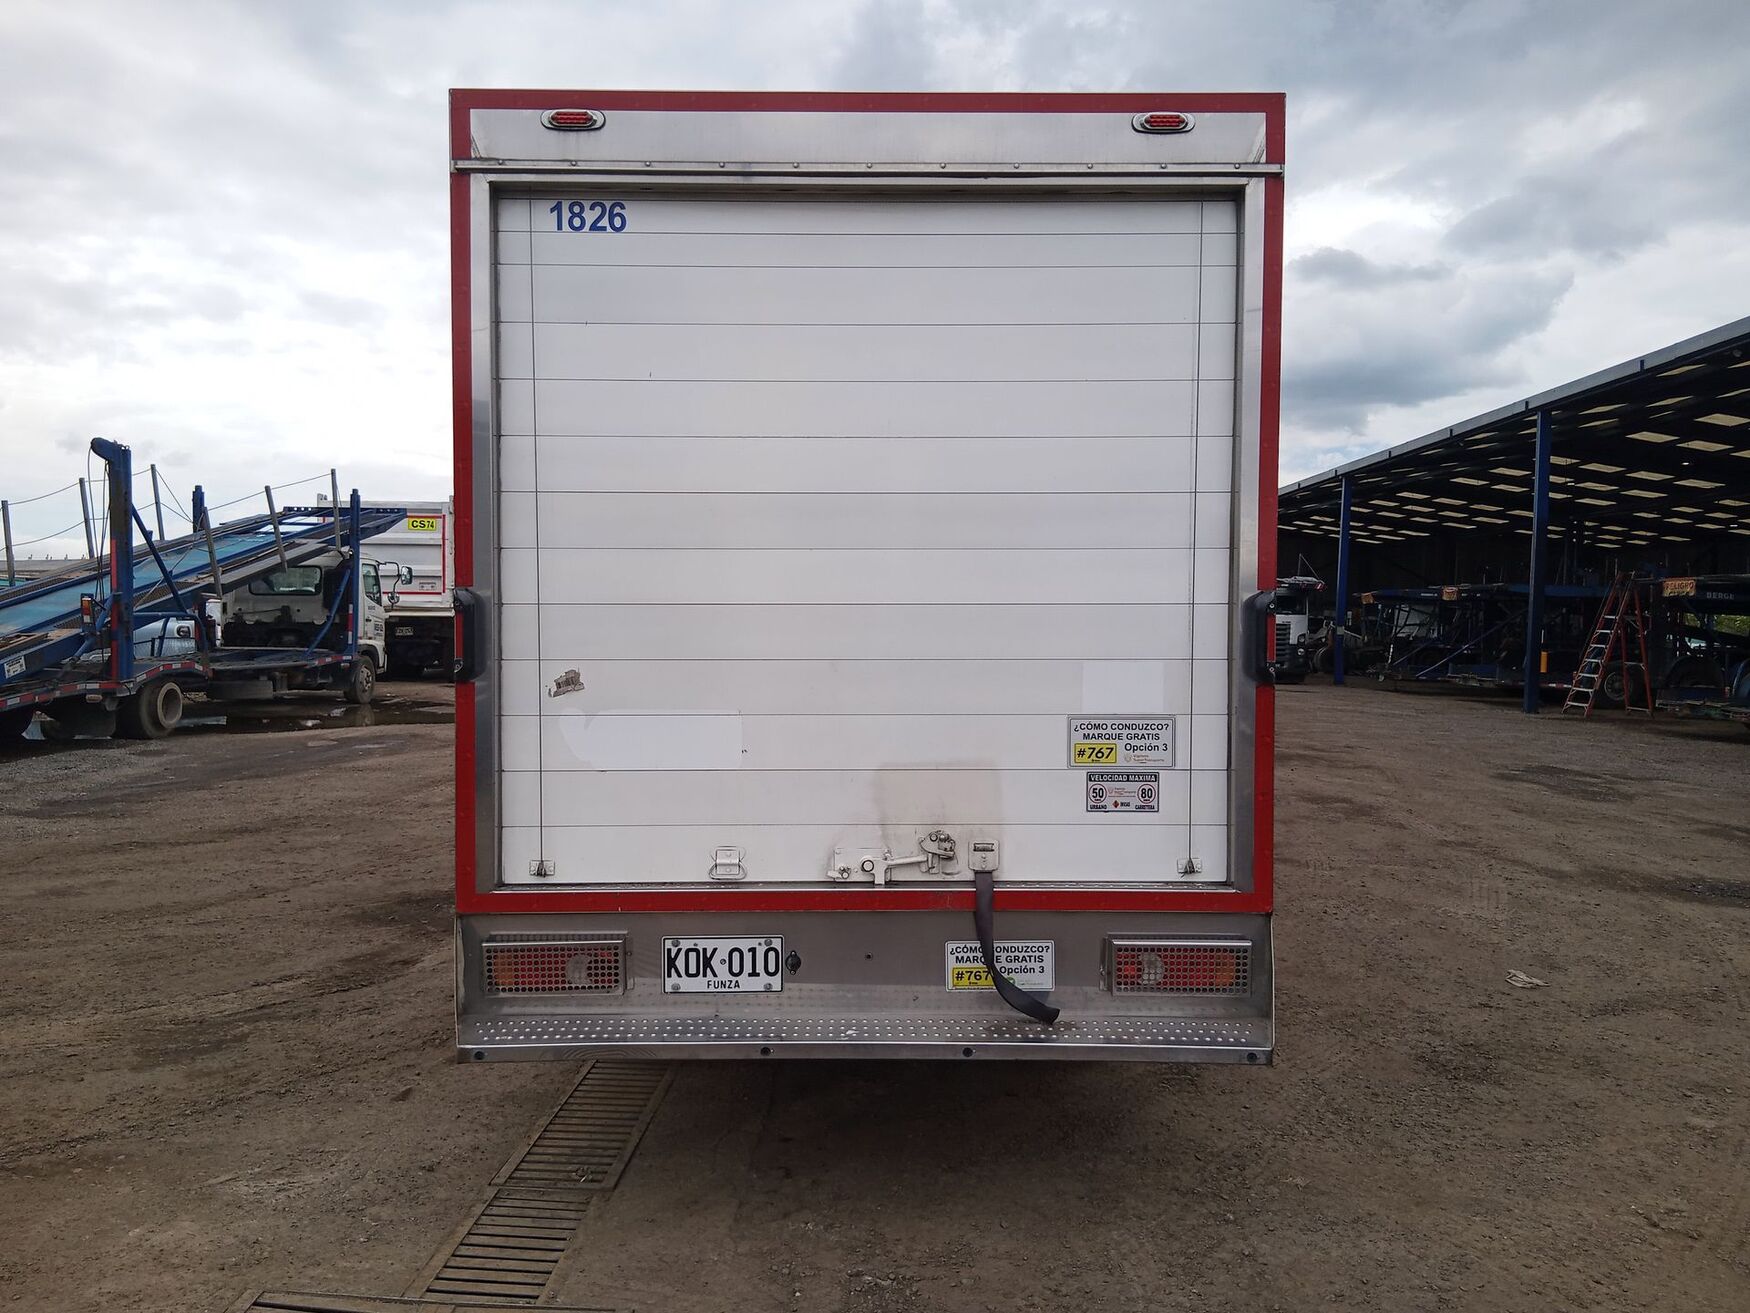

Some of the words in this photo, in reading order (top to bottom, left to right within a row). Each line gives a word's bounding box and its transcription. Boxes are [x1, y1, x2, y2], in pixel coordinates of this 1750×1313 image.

[550, 201, 627, 232] 1826
[1074, 721, 1108, 732] ¿CÓMO
[1110, 723, 1169, 731] CONDUZCO?
[1082, 733, 1123, 741] MARQUE
[1077, 747, 1114, 759] #767
[1124, 743, 1159, 753] Opción
[1162, 743, 1168, 751] 3
[1092, 787, 1104, 798] 50
[1141, 787, 1153, 798] 80
[993, 945, 1050, 953] ONDUZCO?
[1005, 955, 1044, 963] GRATIS
[955, 970, 990, 981] #767
[999, 966, 1035, 975] Opción
[707, 980, 740, 989] FUNZA
